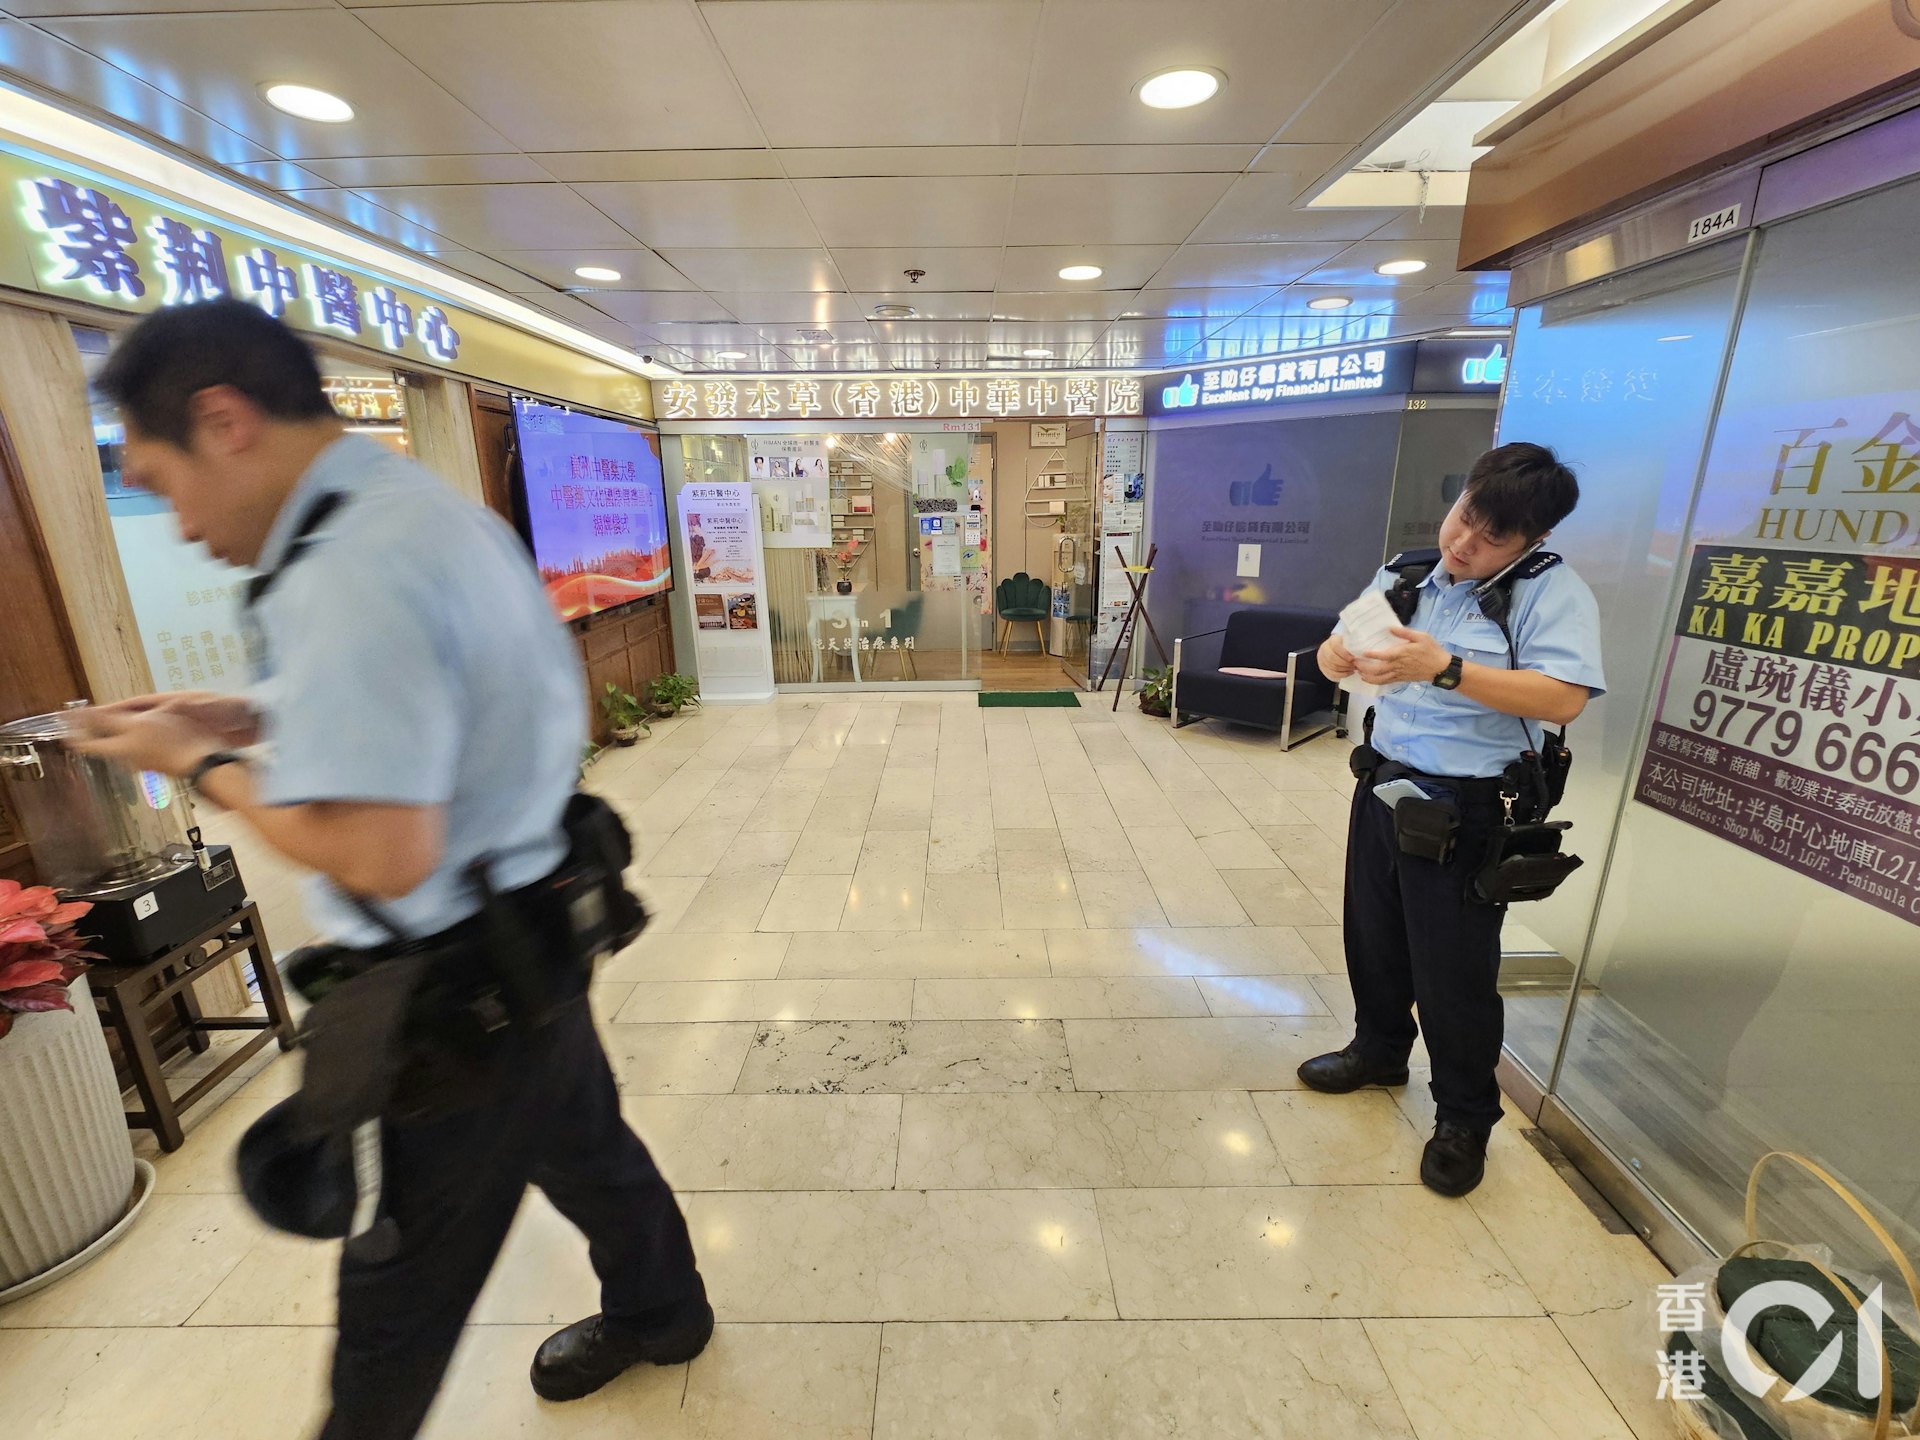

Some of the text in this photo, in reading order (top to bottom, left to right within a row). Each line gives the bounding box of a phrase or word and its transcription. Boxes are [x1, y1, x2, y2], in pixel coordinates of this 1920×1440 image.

[1691, 209, 1735, 239] 184A
[1276, 379, 1330, 398] Financial
[1332, 374, 1384, 392] Limited
[1407, 399, 1427, 410] 132
[943, 423, 980, 431] Rm131
[1754, 508, 1920, 547] HUND
[1687, 605, 1725, 638] KA
[1741, 612, 1785, 648] KA
[1701, 646, 1920, 737] 盧琬儀小
[1689, 689, 1920, 795] 9779 666
[1642, 784, 1678, 809] Company
[1679, 800, 1721, 827] Address:
[1723, 817, 1748, 839] Shop
[1749, 826, 1768, 847] No.
[1770, 836, 1795, 861] L21,
[1838, 865, 1906, 908] Peninsula
[143, 899, 151, 912] 3
